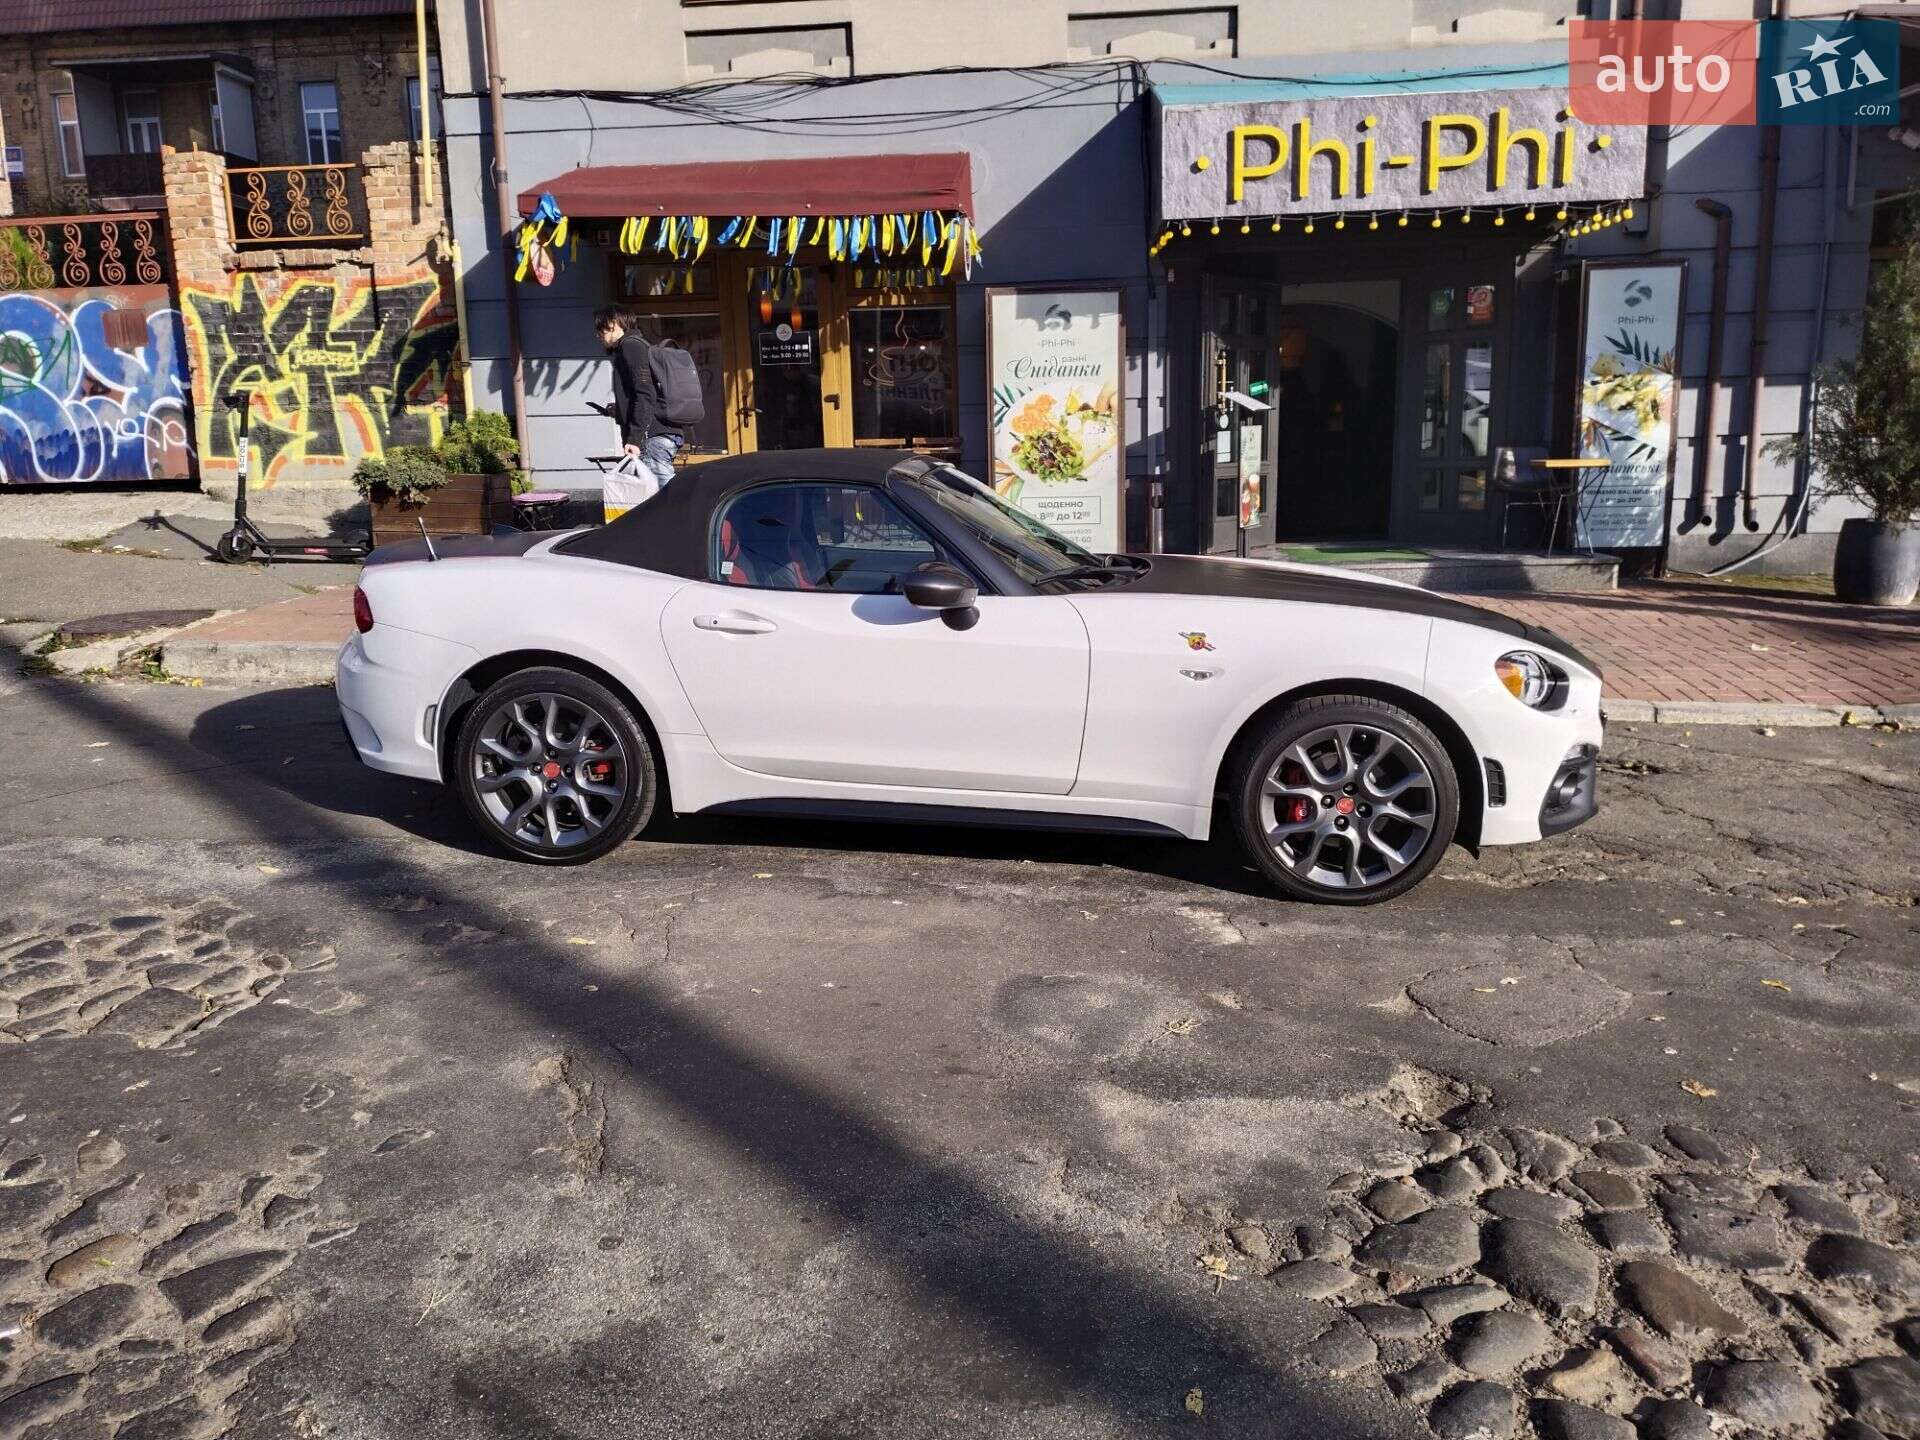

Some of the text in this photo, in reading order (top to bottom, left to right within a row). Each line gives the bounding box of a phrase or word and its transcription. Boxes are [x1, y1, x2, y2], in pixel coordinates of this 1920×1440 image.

[1233, 107, 1576, 201] Phi-Phi
[1617, 314, 1655, 325] Phi-Phi
[1041, 338, 1075, 348] Phi-Phi
[1061, 354, 1087, 363] ранні
[1038, 501, 1084, 510] ЩОДЕННО
[1056, 512, 1071, 521] до
